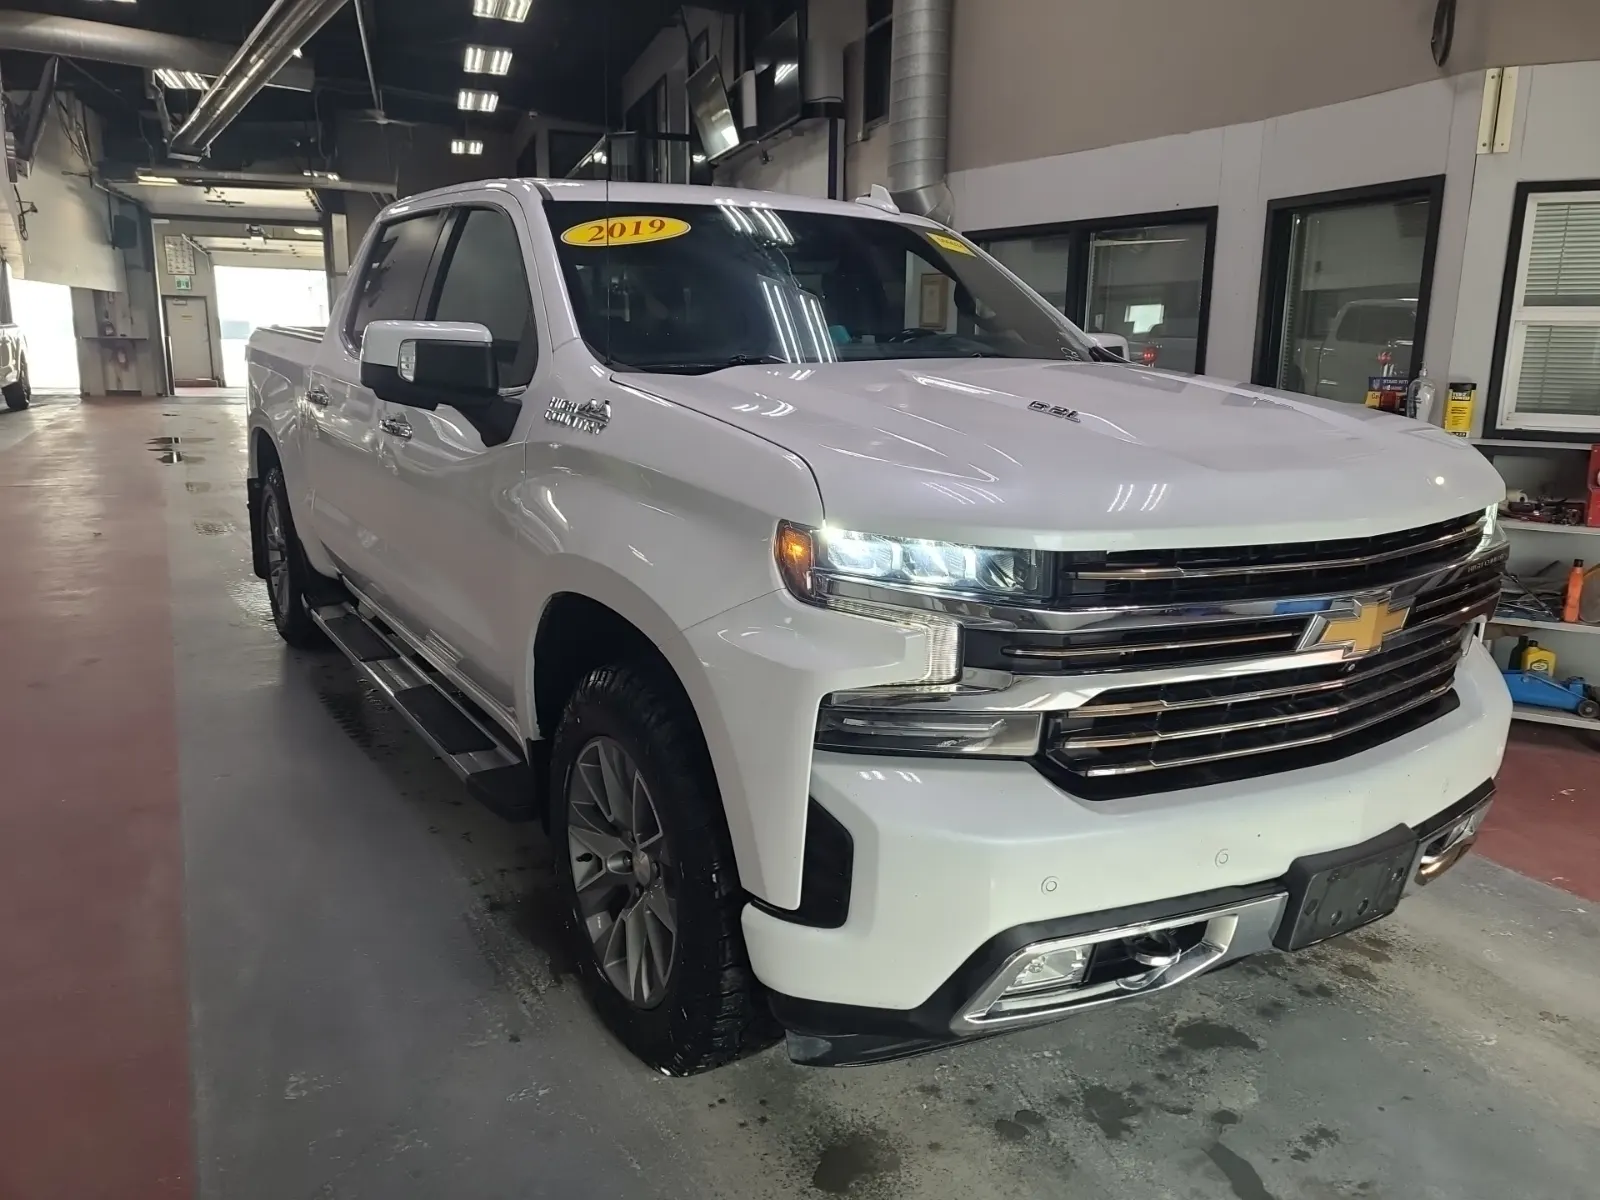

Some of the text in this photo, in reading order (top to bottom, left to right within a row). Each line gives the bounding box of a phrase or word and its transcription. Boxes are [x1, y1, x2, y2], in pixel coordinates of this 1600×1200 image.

[588, 219, 666, 242] 2019
[549, 396, 580, 413] HIGH
[544, 408, 607, 435] COUNTRY
